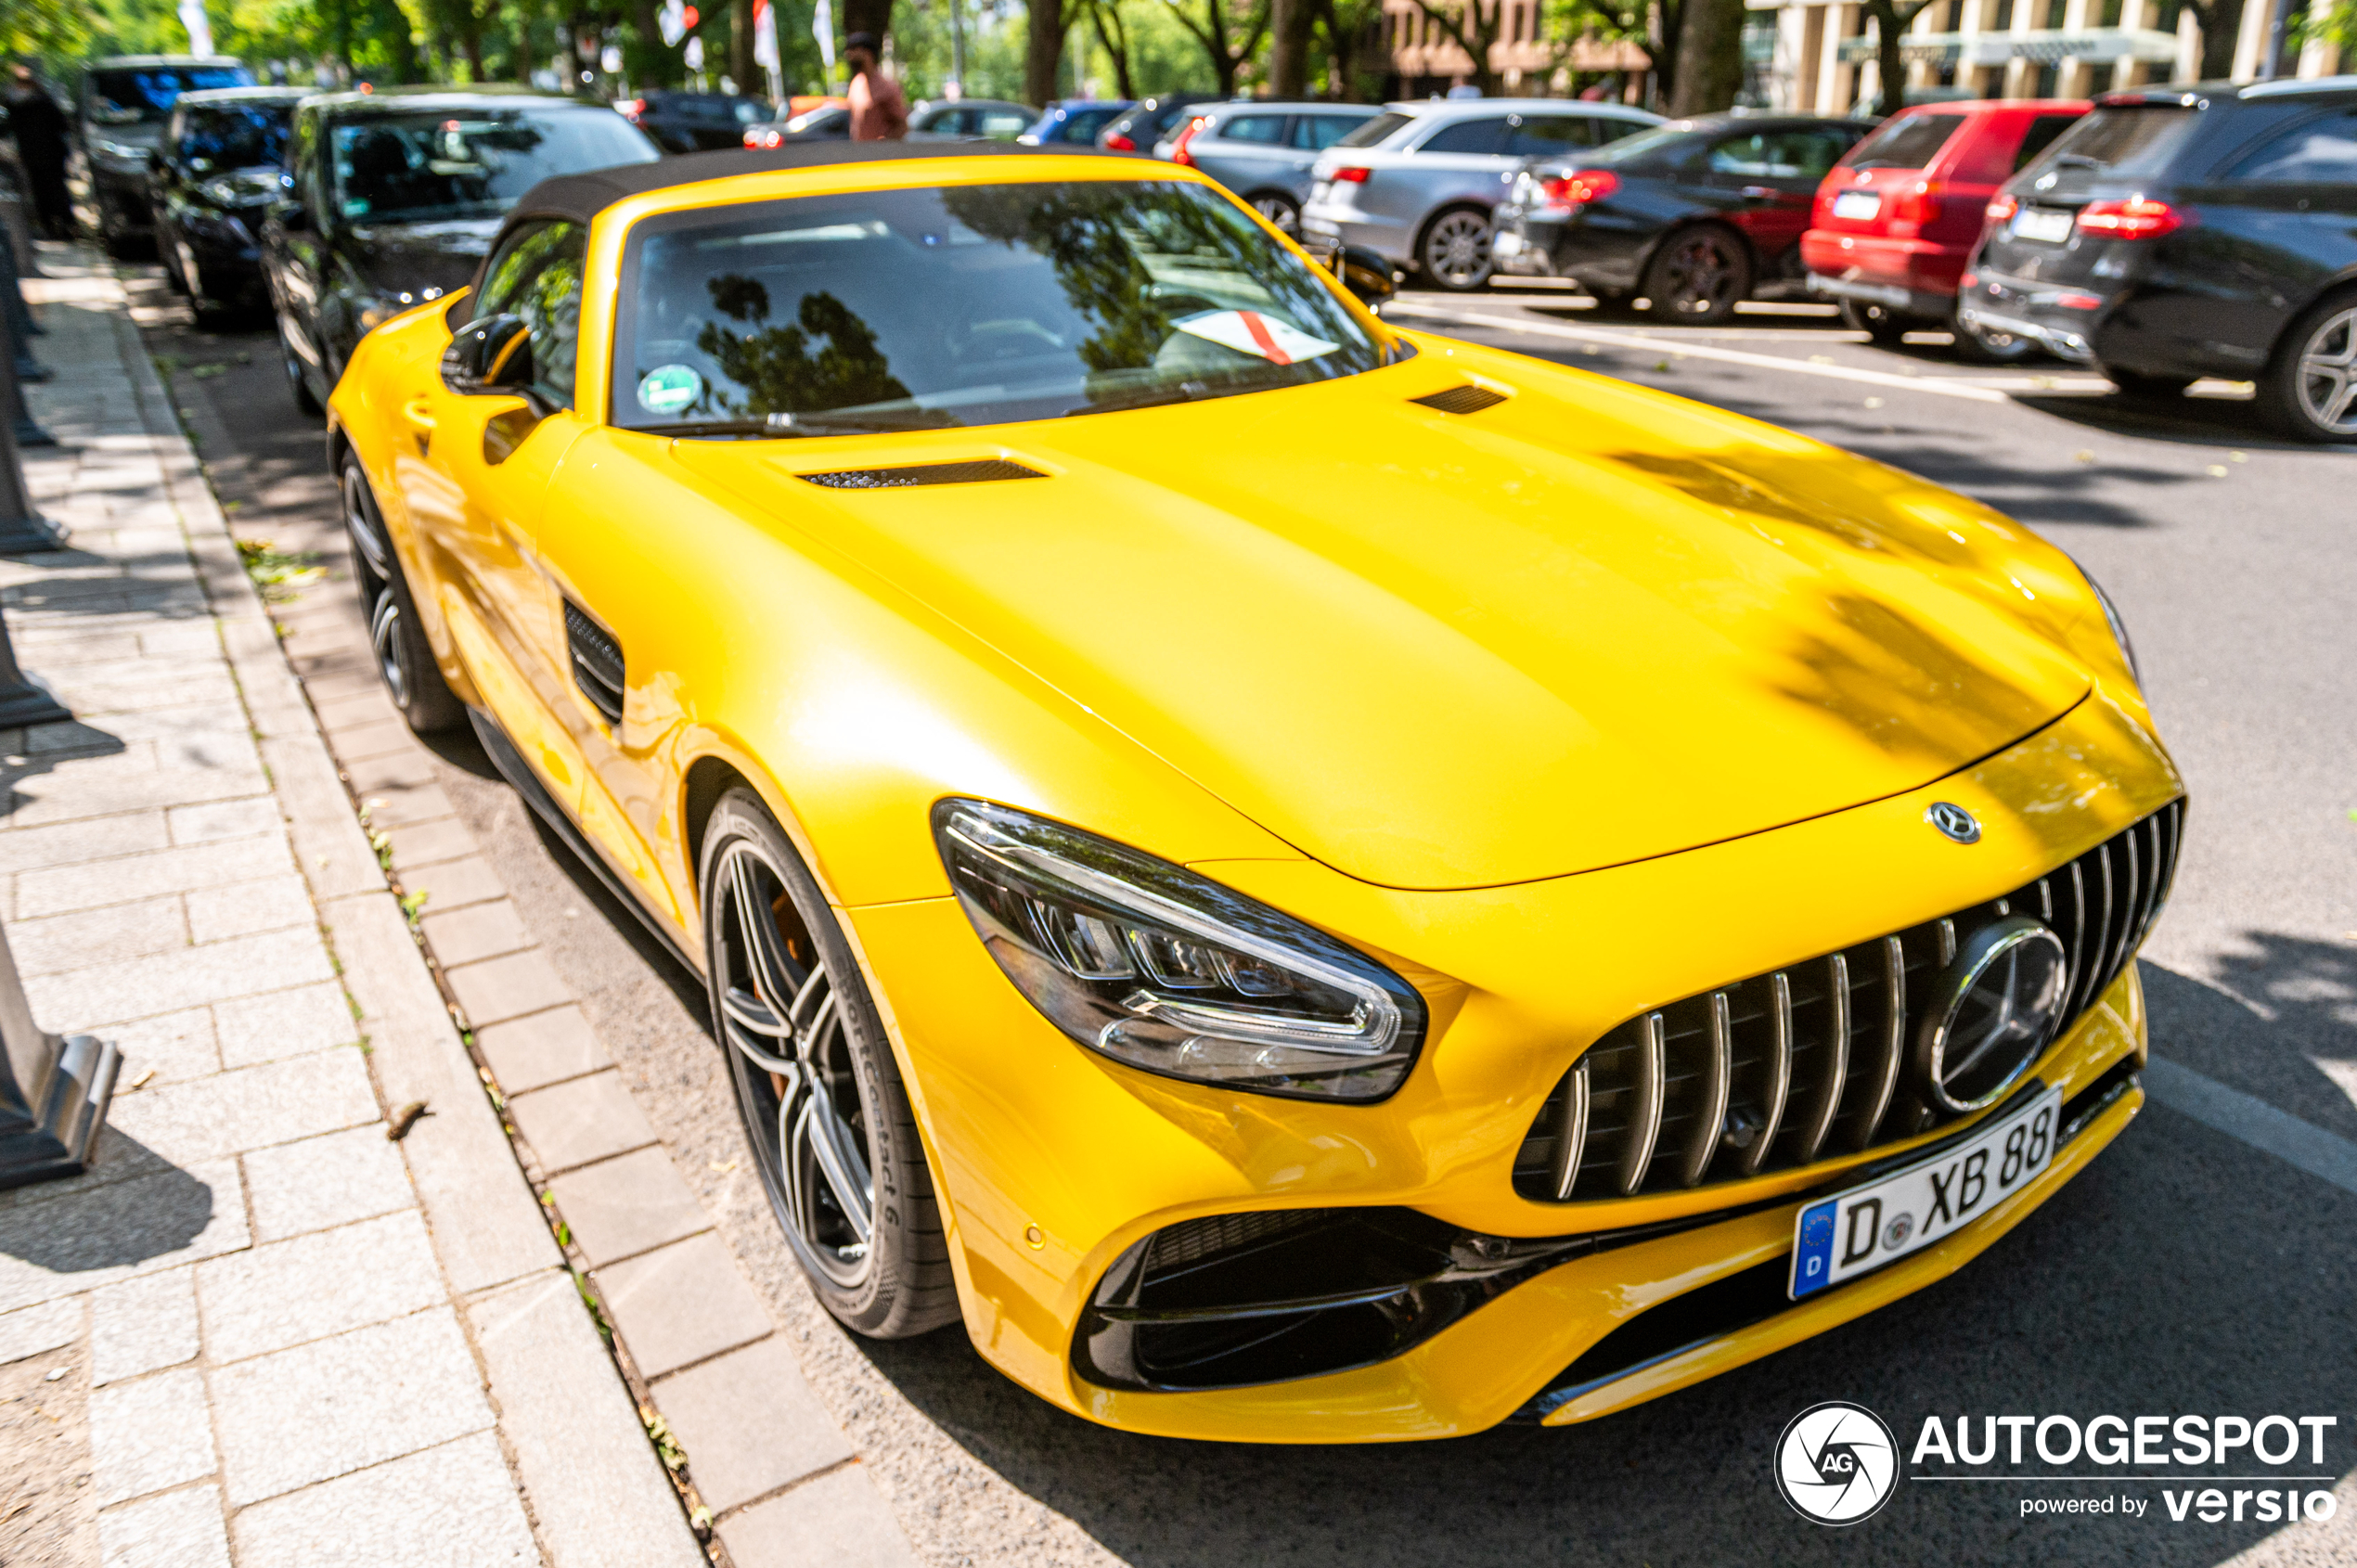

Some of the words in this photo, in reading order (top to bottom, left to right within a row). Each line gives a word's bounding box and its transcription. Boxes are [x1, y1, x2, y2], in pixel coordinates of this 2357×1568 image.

[1840, 1198, 1882, 1267] D
[1922, 1148, 1989, 1235] XB
[1999, 1106, 2052, 1189] 88
[1806, 1255, 1822, 1278] D
